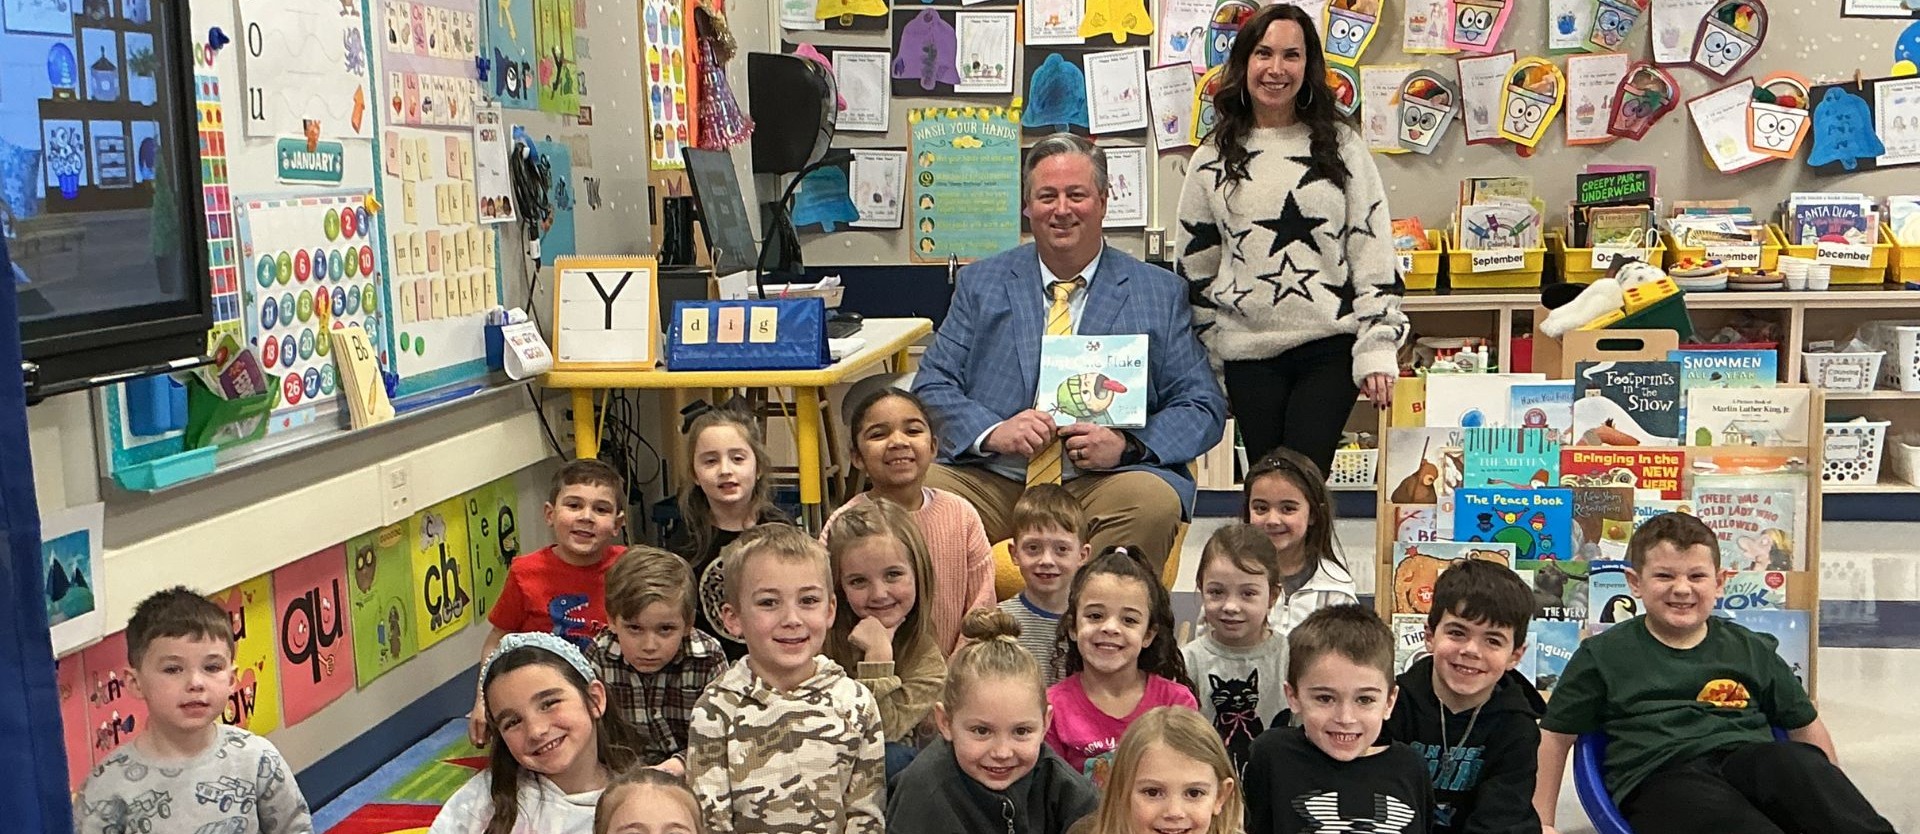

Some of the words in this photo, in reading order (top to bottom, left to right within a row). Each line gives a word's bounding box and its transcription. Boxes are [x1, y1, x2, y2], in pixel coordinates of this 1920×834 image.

[250, 88, 265, 120] u
[914, 123, 946, 141] WASH
[950, 121, 977, 134] YOUR
[982, 122, 1018, 140] HANDS
[290, 149, 336, 173] JANUARY
[1581, 181, 1646, 202] UNDERWEAR!
[1582, 176, 1615, 192] CREEPY
[1617, 173, 1635, 186] PAIR
[345, 216, 351, 230] 2
[1473, 254, 1523, 267] September
[1818, 249, 1870, 262] December
[263, 266, 269, 279] 4
[281, 262, 288, 275] 5
[300, 258, 306, 271] 6
[349, 256, 355, 269] 9
[361, 254, 370, 267] 10
[265, 307, 274, 321] 11
[301, 299, 309, 311] 13
[334, 294, 343, 307] 15
[586, 271, 634, 330] Y
[691, 319, 700, 331] d
[728, 318, 734, 330] i
[759, 319, 769, 333] g
[267, 344, 275, 357] 18
[285, 343, 293, 356] 19
[302, 338, 312, 351] 20
[352, 335, 369, 361] Bb
[1107, 355, 1142, 368] Flake
[1684, 356, 1762, 369] SNOWMEN
[286, 381, 300, 395] 26
[306, 375, 317, 390] 27
[322, 371, 333, 385] 28
[1605, 371, 1675, 388] Footprints
[1542, 394, 1555, 402] You
[1623, 385, 1633, 394] in
[1642, 386, 1658, 397] the
[1628, 394, 1674, 412] Snow
[1712, 405, 1738, 413] Martin
[1739, 405, 1762, 413] Luther
[1573, 452, 1635, 466] Bringing
[1654, 454, 1679, 465] the
[1642, 466, 1679, 478] NEW
[1465, 494, 1488, 505] The
[1493, 494, 1530, 506] Peace
[1533, 494, 1564, 506] Book
[1699, 494, 1732, 504] THERE
[1737, 494, 1759, 505] WAS
[1763, 495, 1771, 505] A
[1728, 505, 1755, 516] LADY
[1756, 509, 1778, 521] WHO
[481, 517, 489, 537] e
[1718, 532, 1734, 541] ME
[476, 544, 480, 569] i
[424, 543, 463, 617] ch
[486, 567, 493, 587] o
[1543, 606, 1561, 617] THE
[1562, 606, 1588, 618] VERY
[227, 605, 247, 642] u
[282, 578, 344, 684] qu
[1535, 642, 1573, 661] nguin
